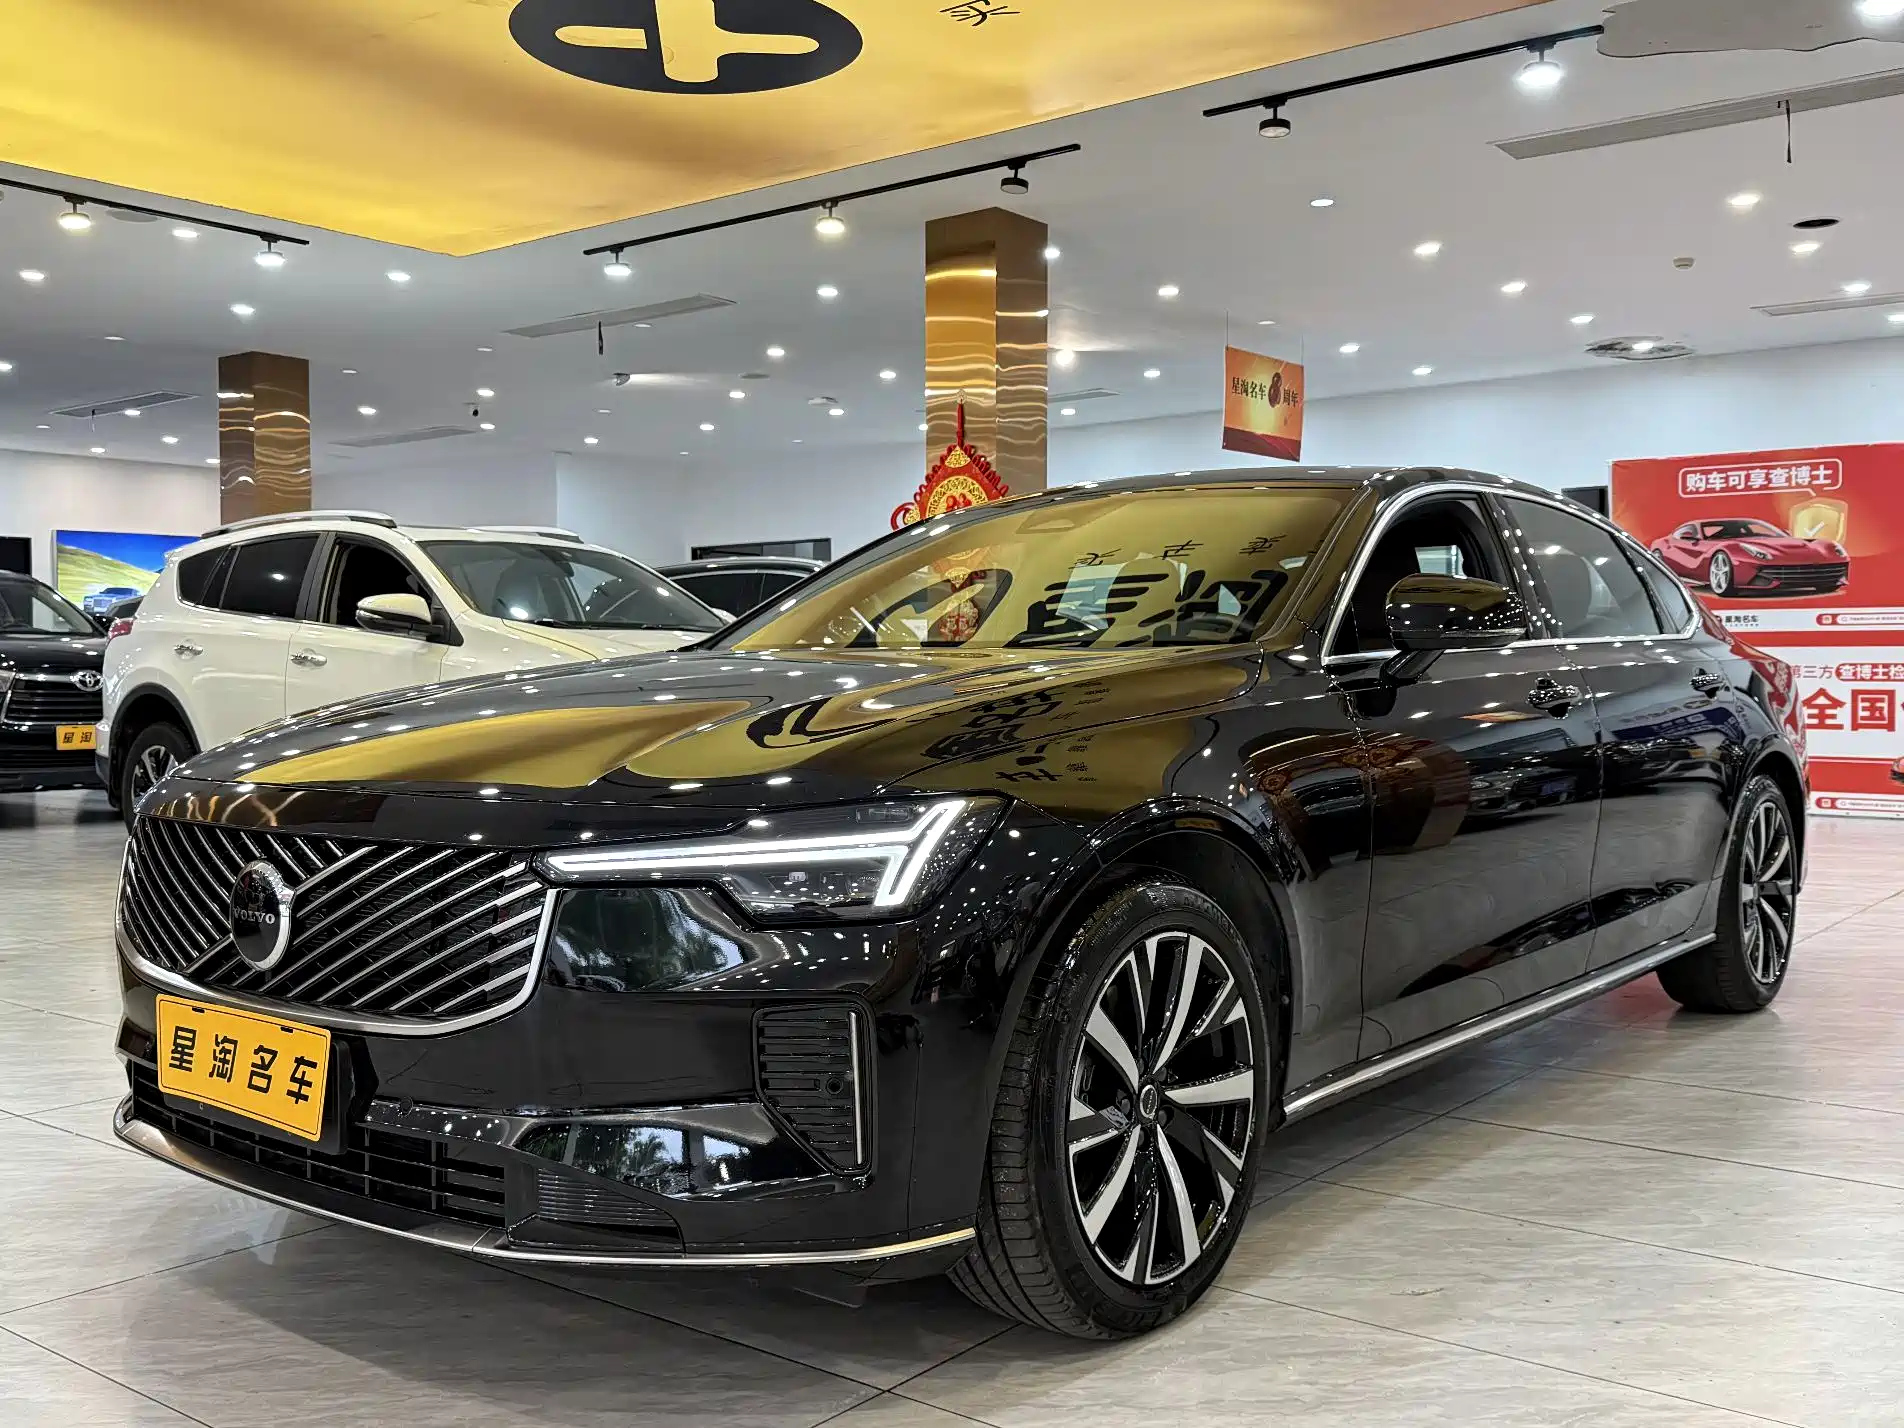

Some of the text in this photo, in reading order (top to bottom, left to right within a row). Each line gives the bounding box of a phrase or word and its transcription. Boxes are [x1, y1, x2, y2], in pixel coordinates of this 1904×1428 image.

[1686, 464, 1833, 492] 购车可享查博士
[1801, 687, 1904, 732] 全国
[233, 905, 276, 925] VOLVO
[168, 1025, 319, 1105] 星淘名车
